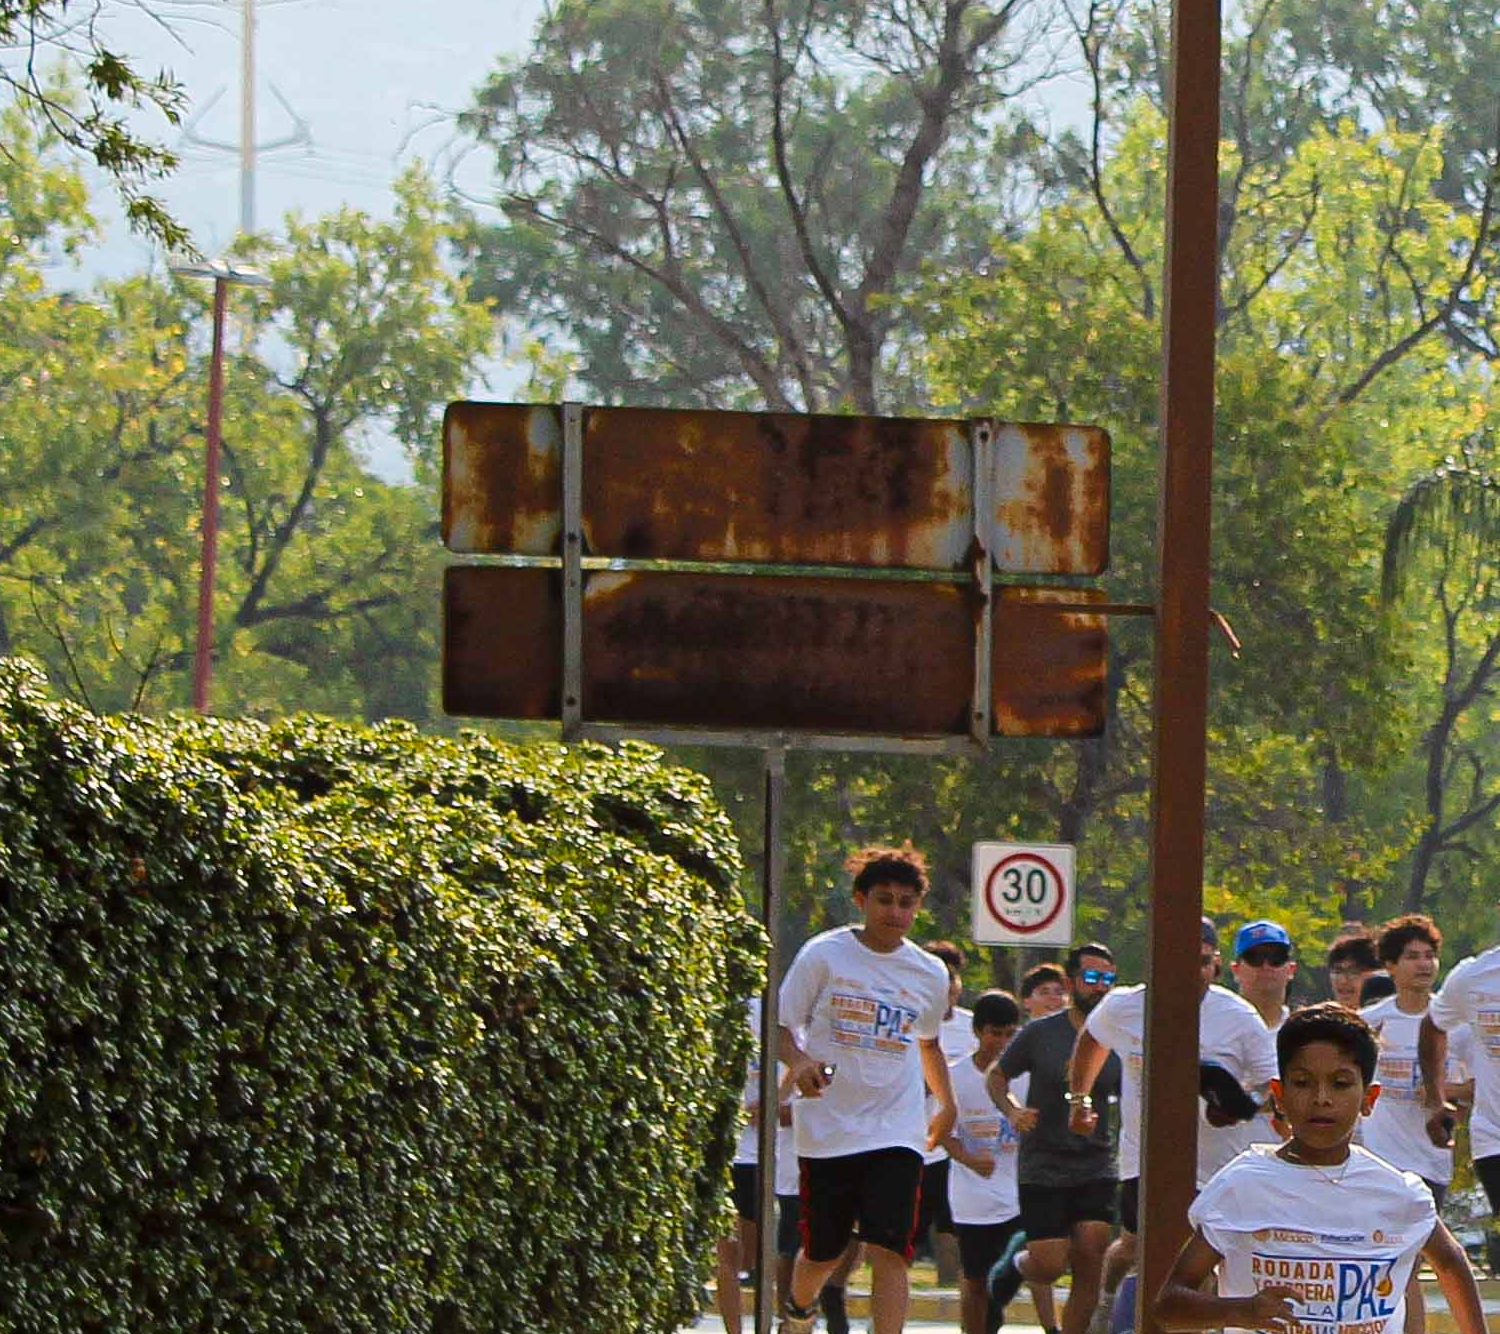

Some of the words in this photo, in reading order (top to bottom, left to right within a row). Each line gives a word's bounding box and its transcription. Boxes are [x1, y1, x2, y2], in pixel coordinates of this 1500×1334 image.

[1002, 867, 1046, 904] 30
[875, 1004, 917, 1043] PAZ
[1252, 1257, 1334, 1280] RODADA
[1337, 1259, 1398, 1321] PAZ
[1307, 1304, 1334, 1317] LA
